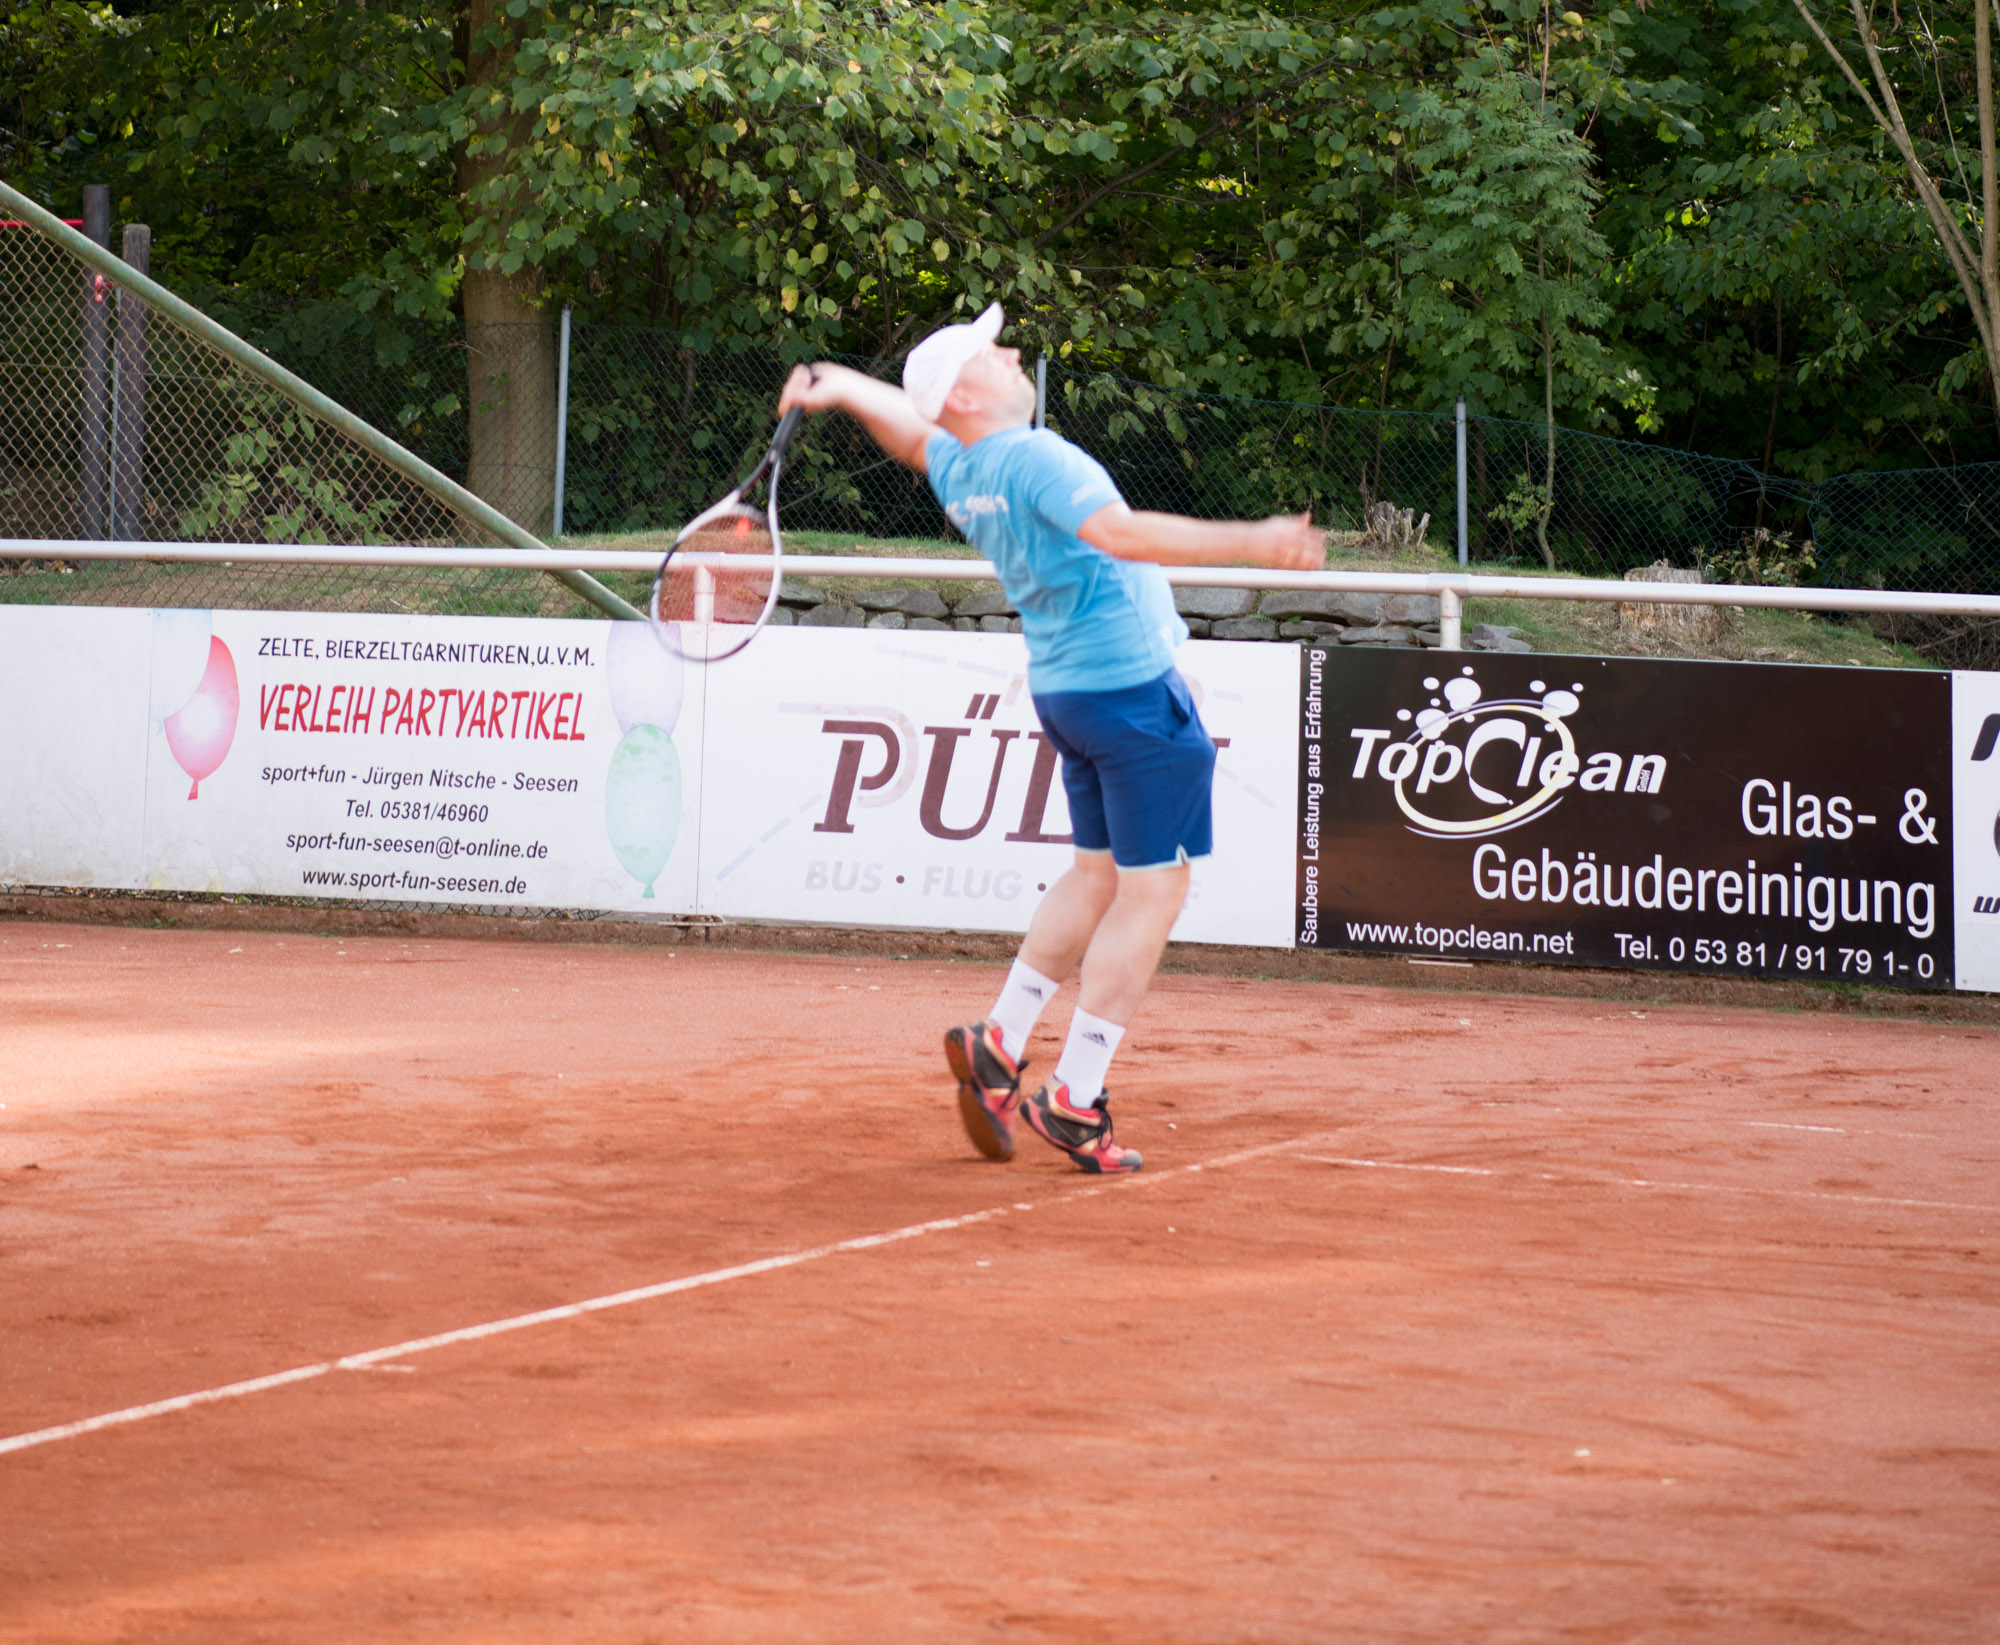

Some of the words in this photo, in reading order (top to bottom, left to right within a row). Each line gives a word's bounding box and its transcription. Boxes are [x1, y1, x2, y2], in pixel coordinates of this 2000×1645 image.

[258, 638, 319, 659] ZELTE,
[260, 683, 375, 735] VERLEIH
[380, 687, 586, 741] PARTYARTIKEL
[1305, 649, 1326, 739] Erfahrung
[261, 765, 346, 786] sport+fun
[362, 767, 424, 790] Jürgen
[429, 769, 496, 790] Nitsche
[513, 772, 579, 792] Seesen
[1308, 744, 1321, 778] aus
[1350, 718, 1667, 805] TopClean
[346, 799, 374, 819] Tel.
[380, 801, 489, 823] 05381/46960
[1303, 782, 1324, 860] Leistung
[1741, 778, 1876, 840] Glas-
[1898, 788, 1939, 844] &
[286, 832, 548, 860] sport-fun-seesen@t-online.de
[302, 868, 527, 894] www.sport-fun-seesen.de
[804, 860, 883, 894] BUS
[921, 865, 1023, 900] FLUG
[1472, 843, 1936, 938] Gebäudereinigung
[1301, 866, 1319, 944] Saubere
[1346, 922, 1574, 954] www.topclean.net
[1614, 933, 1659, 960] Tel.
[1669, 936, 1685, 962] 0
[1694, 939, 1727, 965] 53
[1736, 941, 1766, 967] 81
[1777, 944, 1787, 968] /
[1795, 945, 1825, 971] 91
[1838, 948, 1872, 974] 79
